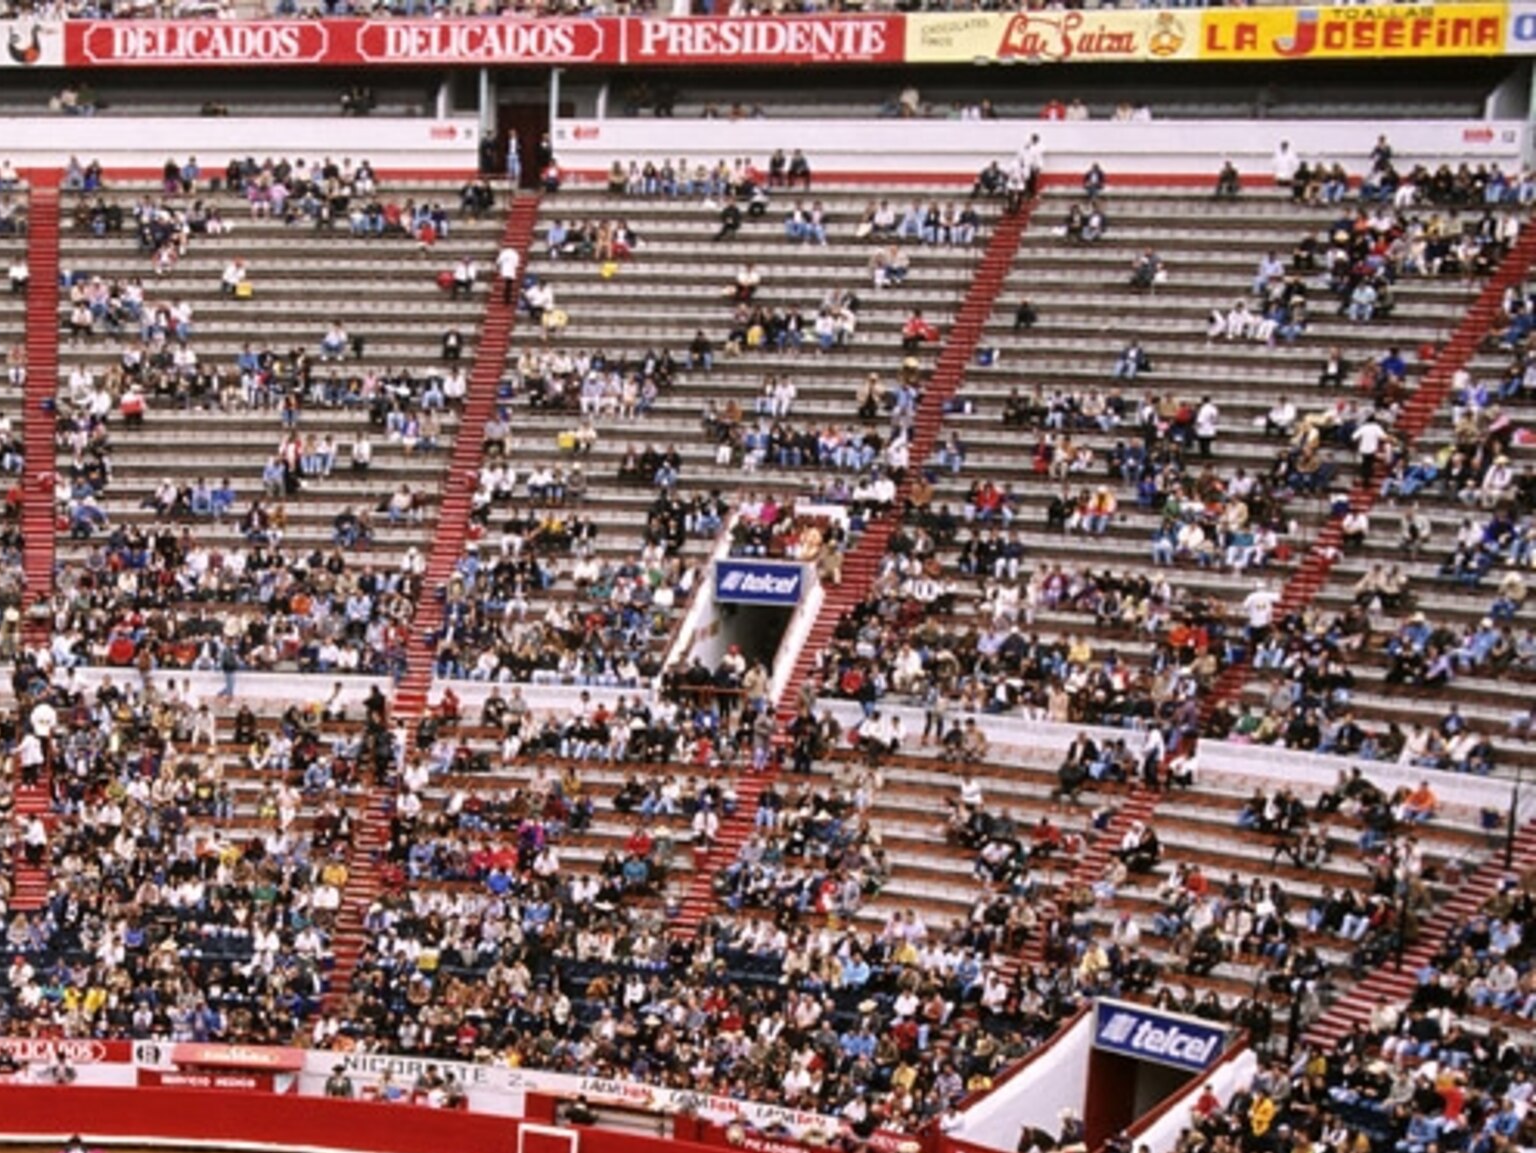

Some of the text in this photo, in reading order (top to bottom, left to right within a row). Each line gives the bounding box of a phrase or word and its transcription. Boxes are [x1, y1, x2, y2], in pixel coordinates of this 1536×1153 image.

[111, 25, 300, 58] DELICADOS
[384, 25, 575, 58] DELICADOS
[638, 19, 887, 55] PRESIDENTE
[1206, 23, 1258, 51] LA
[741, 572, 800, 595] telcel
[1131, 1020, 1218, 1063] telcel
